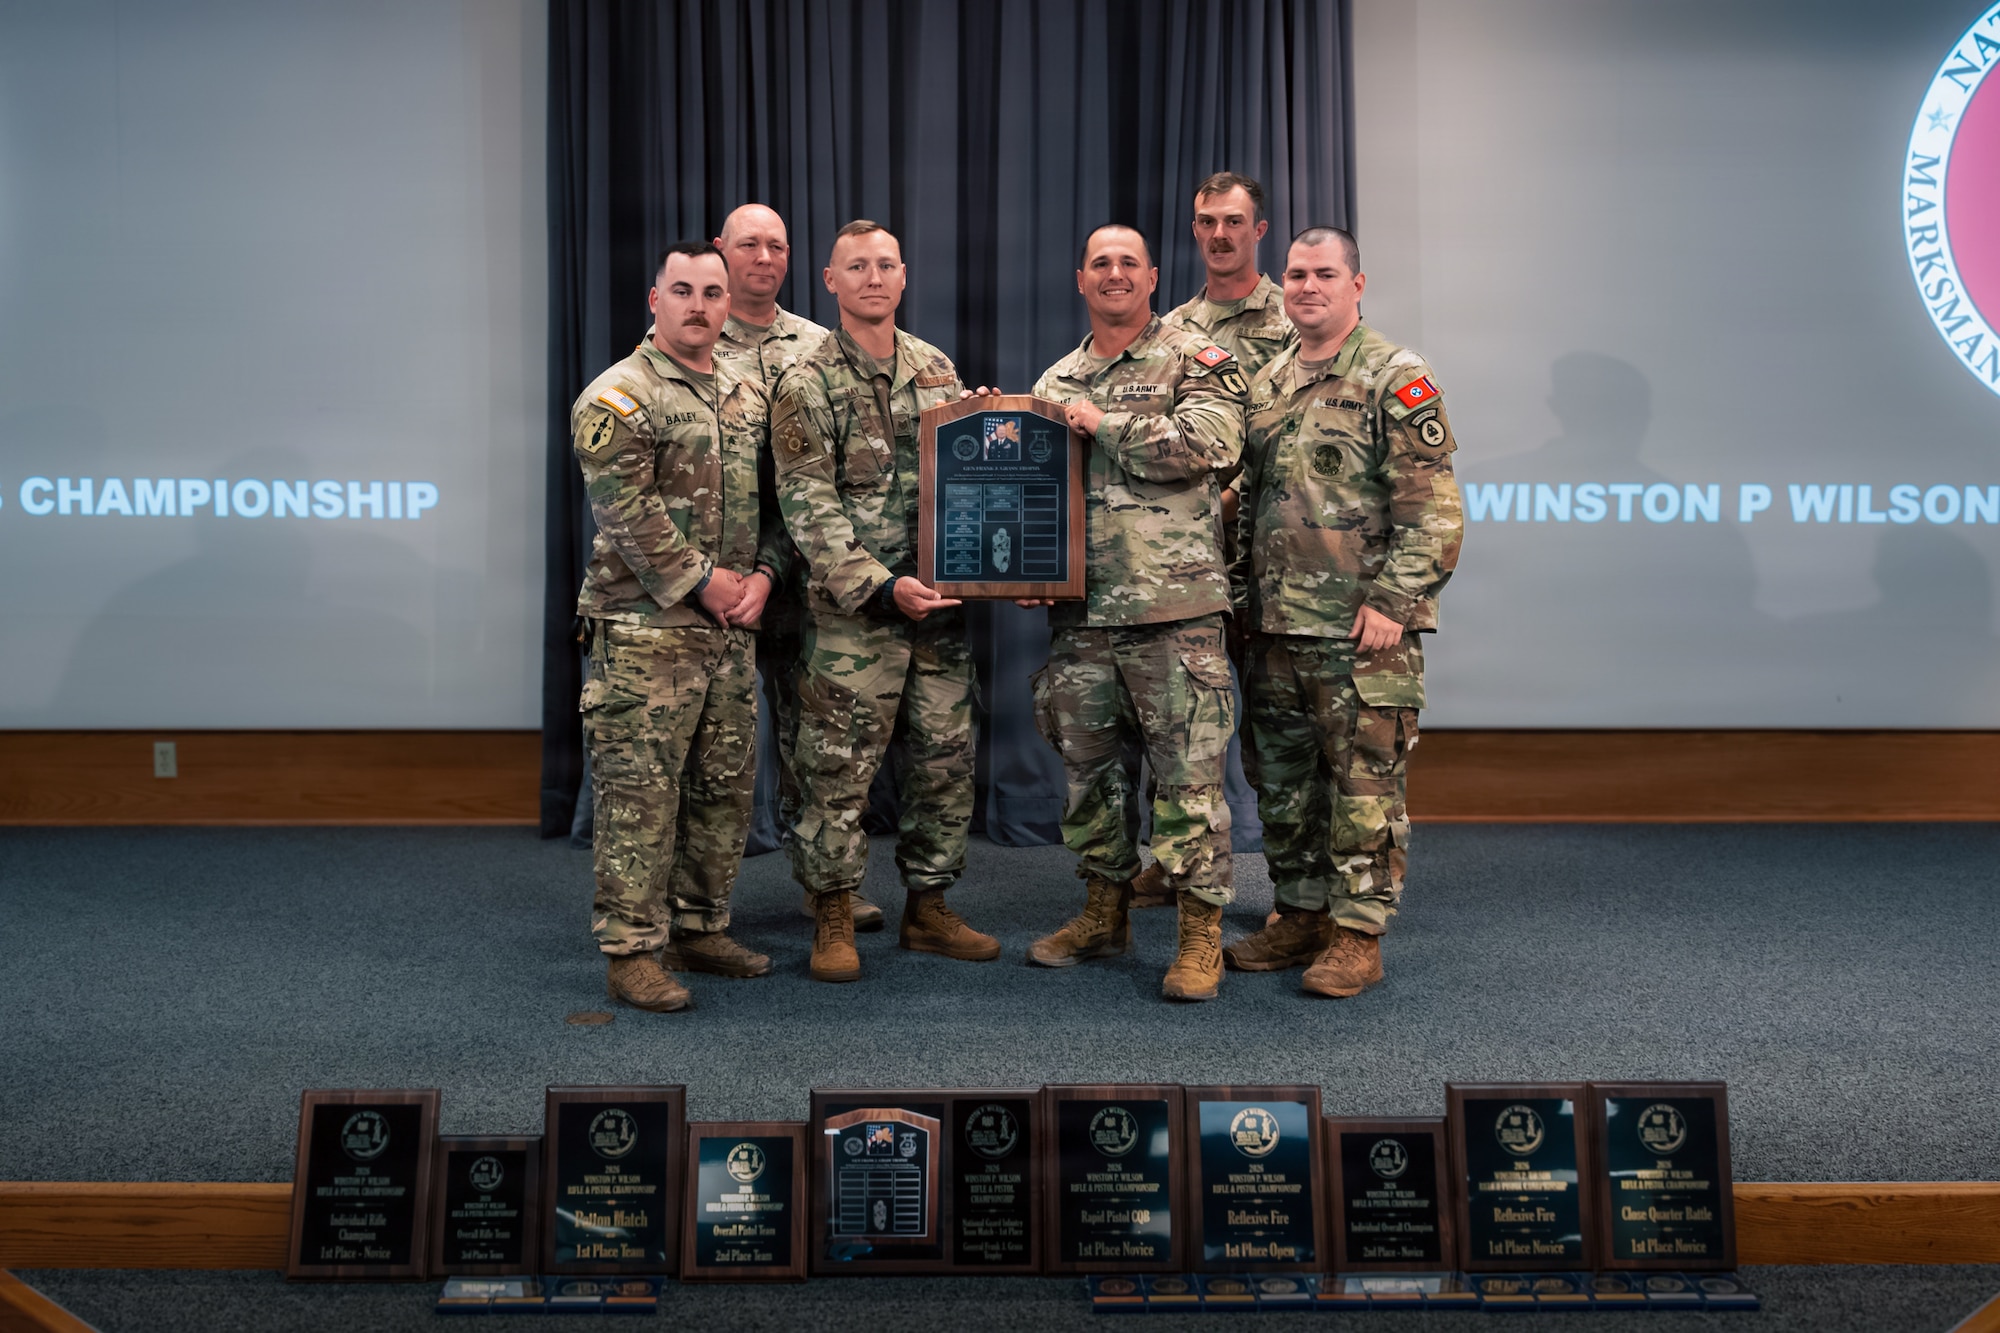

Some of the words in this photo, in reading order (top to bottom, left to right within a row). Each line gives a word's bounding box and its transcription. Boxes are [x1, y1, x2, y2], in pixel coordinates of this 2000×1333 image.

[1941, 10, 2000, 93] NA
[1136, 385, 1158, 393] ARMY
[1325, 398, 1338, 407] U.S.
[1340, 400, 1364, 412] ARMY
[665, 412, 697, 425] BAILEY
[19, 476, 440, 519] CHAMPIONSHIP
[1464, 482, 1721, 523] WINSTON
[1738, 484, 1772, 522] P
[1788, 484, 2000, 525] WILSON
[584, 1175, 611, 1183] WINSTON
[619, 1175, 641, 1183] WILSON
[965, 1174, 991, 1183] WINSTON
[999, 1174, 1021, 1183] WILSON
[1086, 1174, 1113, 1182] WINSTON
[1121, 1174, 1143, 1182] WILSON
[1229, 1175, 1255, 1183] WINSTON
[1263, 1175, 1285, 1183] WILSON
[1071, 1184, 1087, 1192] RIFLE
[1094, 1184, 1115, 1192] PISTOL
[1116, 1183, 1160, 1192] CHAMPIONSHIP
[330, 1213, 367, 1226] Individual
[368, 1213, 386, 1226] Rifle
[1081, 1210, 1104, 1225] Rapid
[1107, 1210, 1130, 1223] Pistol
[1131, 1210, 1150, 1224] CQB
[1228, 1210, 1268, 1225] Reflexive
[1270, 1210, 1289, 1225] Fire
[1494, 1208, 1534, 1222] Reflexive
[1536, 1208, 1555, 1222] Fire
[1622, 1207, 1647, 1221] Close
[1649, 1207, 1684, 1222] Quarter
[1686, 1206, 1712, 1221] Battle
[339, 1229, 376, 1242] Champion
[713, 1225, 737, 1236] Overall
[738, 1225, 758, 1236] Pistol
[759, 1225, 776, 1236] Team
[321, 1246, 333, 1259] 1st
[335, 1246, 356, 1259] Place
[364, 1246, 391, 1259] Novice
[577, 1244, 590, 1258] 1st
[593, 1244, 617, 1258] Place
[620, 1243, 645, 1258] Team
[1079, 1242, 1092, 1256] 1st
[1095, 1242, 1120, 1256] Place
[1123, 1242, 1154, 1256] Novice
[1225, 1243, 1239, 1257] 1st
[1242, 1243, 1267, 1257] Place
[1269, 1243, 1295, 1259] Open
[1489, 1240, 1503, 1255] 1st
[1505, 1240, 1531, 1254] Place
[1533, 1240, 1565, 1254] Novice
[1632, 1239, 1646, 1253] 1st
[1648, 1238, 1673, 1253] Place
[1675, 1239, 1707, 1253] Novice
[716, 1250, 730, 1262] 2nd
[732, 1250, 751, 1261] Place
[754, 1250, 772, 1261] Team
